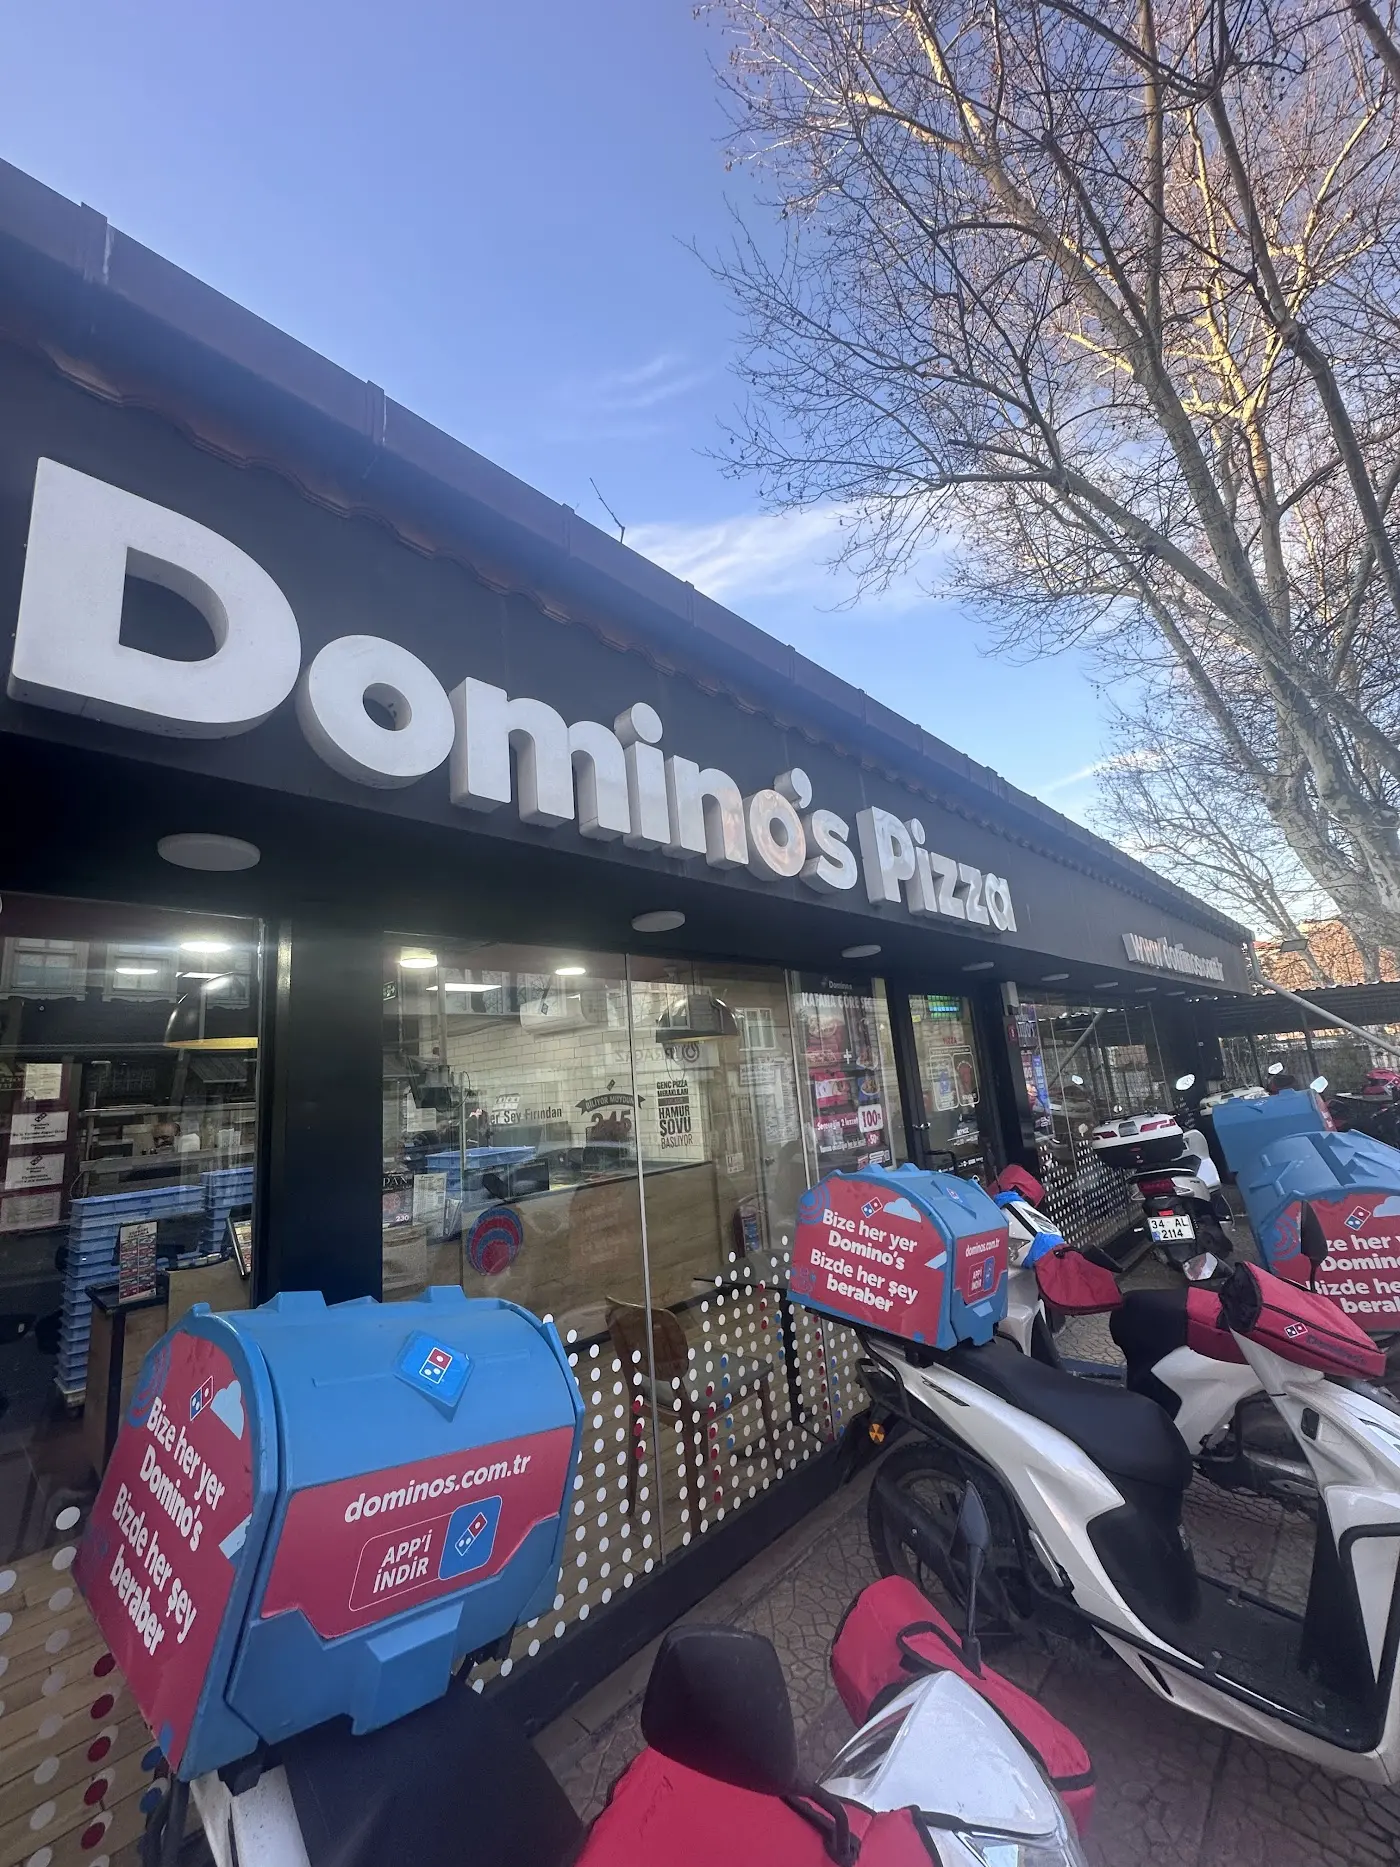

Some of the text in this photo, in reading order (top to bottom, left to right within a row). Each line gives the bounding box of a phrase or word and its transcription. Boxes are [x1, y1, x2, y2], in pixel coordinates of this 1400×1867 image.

[8, 457, 1017, 932] Domino's Pizza
[658, 1105, 690, 1120] HAMUR
[822, 1208, 918, 1253] Bize her yer
[1151, 1218, 1189, 1229] 34 AL
[1161, 1229, 1184, 1239] 2114
[1350, 1234, 1392, 1250] her
[828, 1230, 905, 1271] Domino's
[1320, 1253, 1400, 1272] Domin
[810, 1248, 919, 1305] Bizde her şey
[826, 1274, 894, 1313] beraber
[146, 1396, 226, 1511] Bize her yer
[139, 1444, 203, 1552] Domino's
[344, 1454, 531, 1523] dominos.com.tr
[112, 1483, 197, 1644] Bizde her şey
[381, 1529, 433, 1568] APP'İ
[372, 1556, 430, 1595] İNDİR
[109, 1544, 165, 1656] beraber
